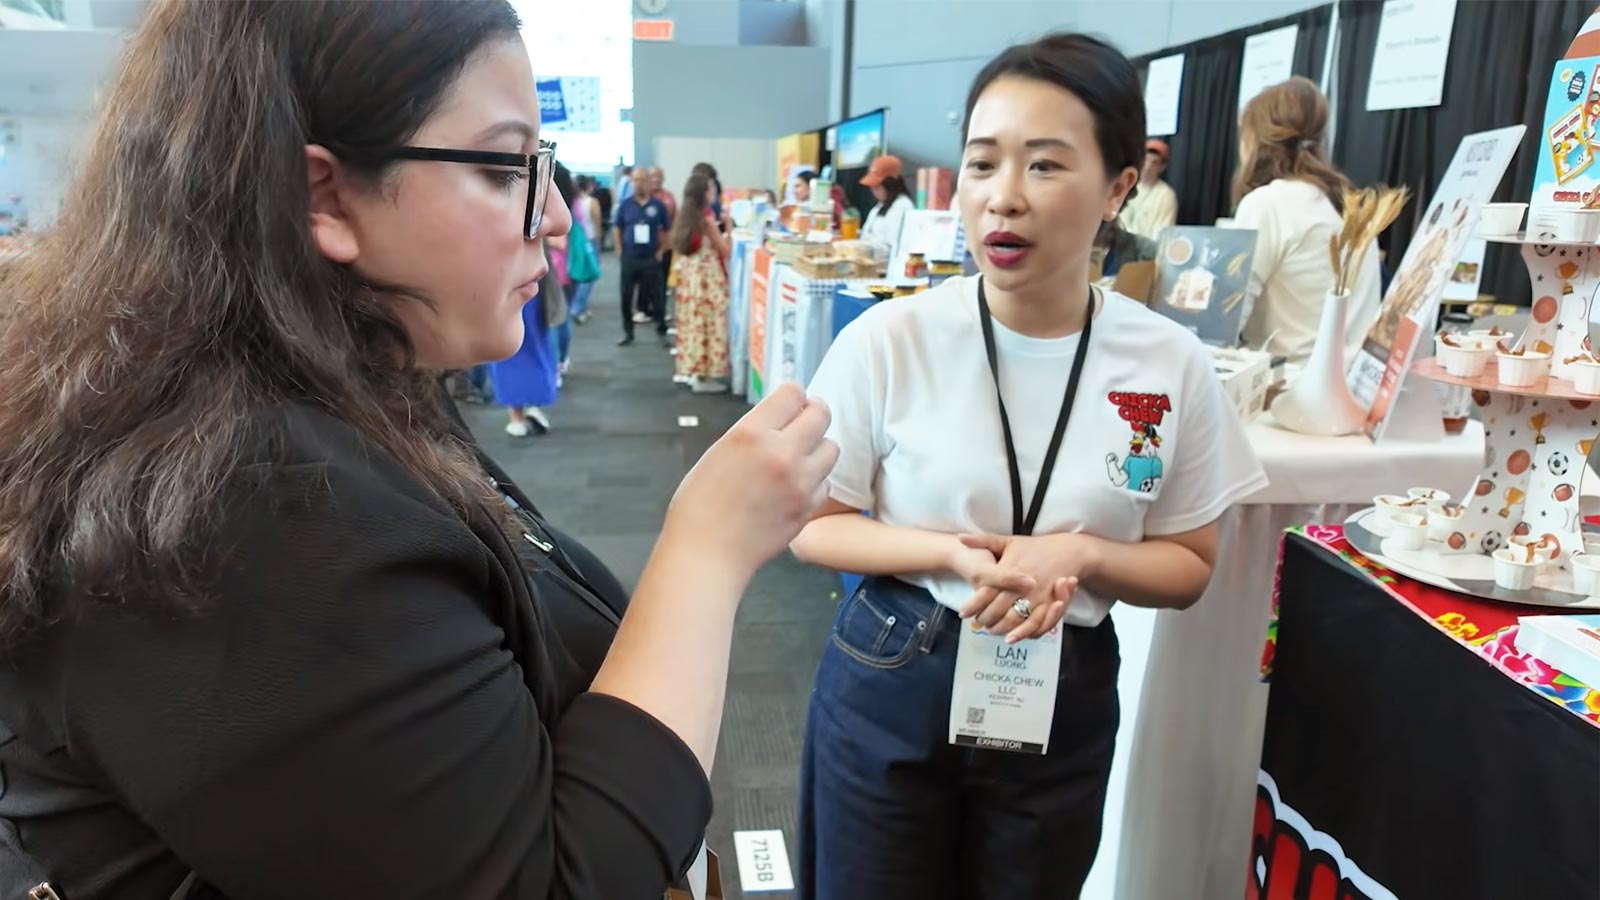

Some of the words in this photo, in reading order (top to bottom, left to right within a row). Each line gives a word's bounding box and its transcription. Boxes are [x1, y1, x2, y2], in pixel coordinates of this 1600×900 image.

[1108, 391, 1171, 412] CHICKA
[1118, 406, 1163, 426] CHEW
[996, 645, 1027, 661] LAN
[994, 659, 1026, 670] LUONG
[974, 671, 1011, 683] CHICKA
[1013, 677, 1044, 687] CHEW
[998, 685, 1016, 695] LLC
[976, 737, 1022, 749] EXHIBITOR
[751, 838, 775, 882] 7125B
